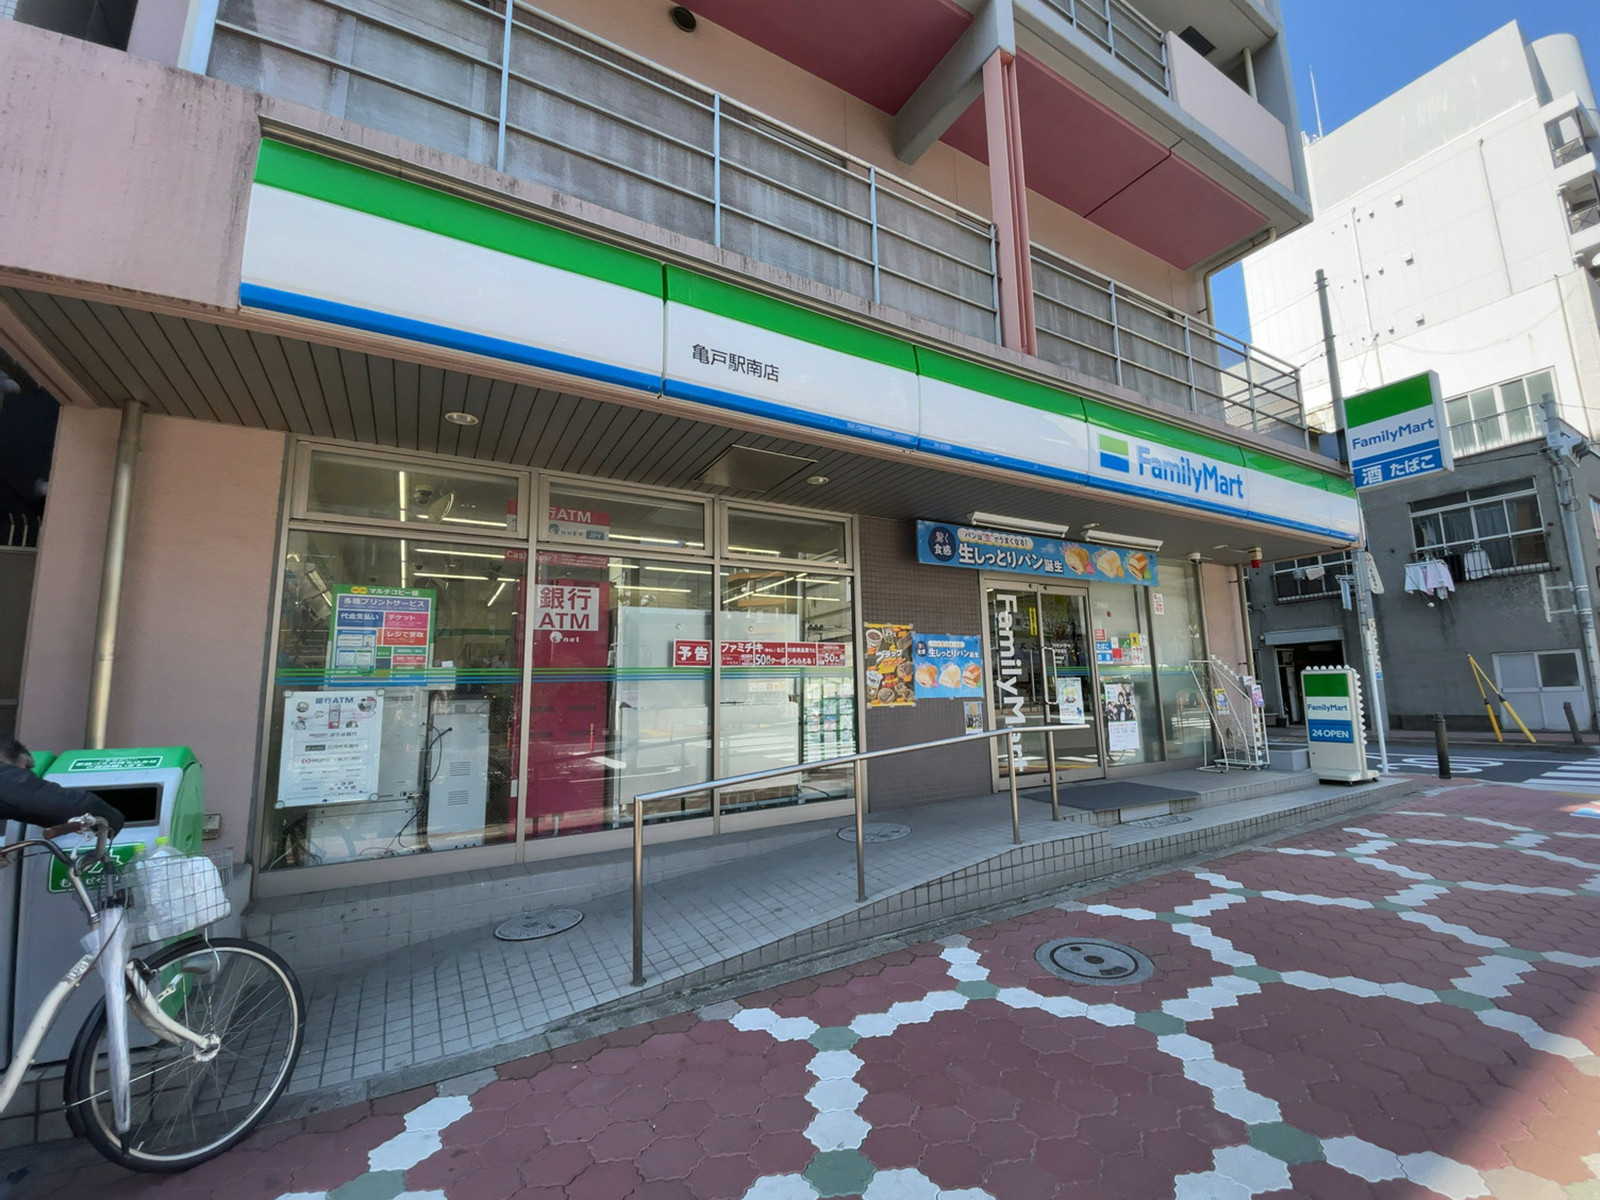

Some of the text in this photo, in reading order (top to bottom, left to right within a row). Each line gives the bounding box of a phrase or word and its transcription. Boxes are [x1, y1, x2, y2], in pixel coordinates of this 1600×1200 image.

[692, 343, 780, 383] 亀戸駅南店
[1352, 418, 1435, 450] FamilyMart
[1137, 444, 1244, 499] FamilyMart
[1361, 454, 1436, 485] 酒 たばこ
[933, 543, 952, 556] 食感
[539, 587, 592, 610] 銀行
[538, 612, 590, 629] ATM
[678, 646, 709, 661] 予告
[720, 643, 764, 653] ファミチキ
[1307, 703, 1348, 712] FamilyMart
